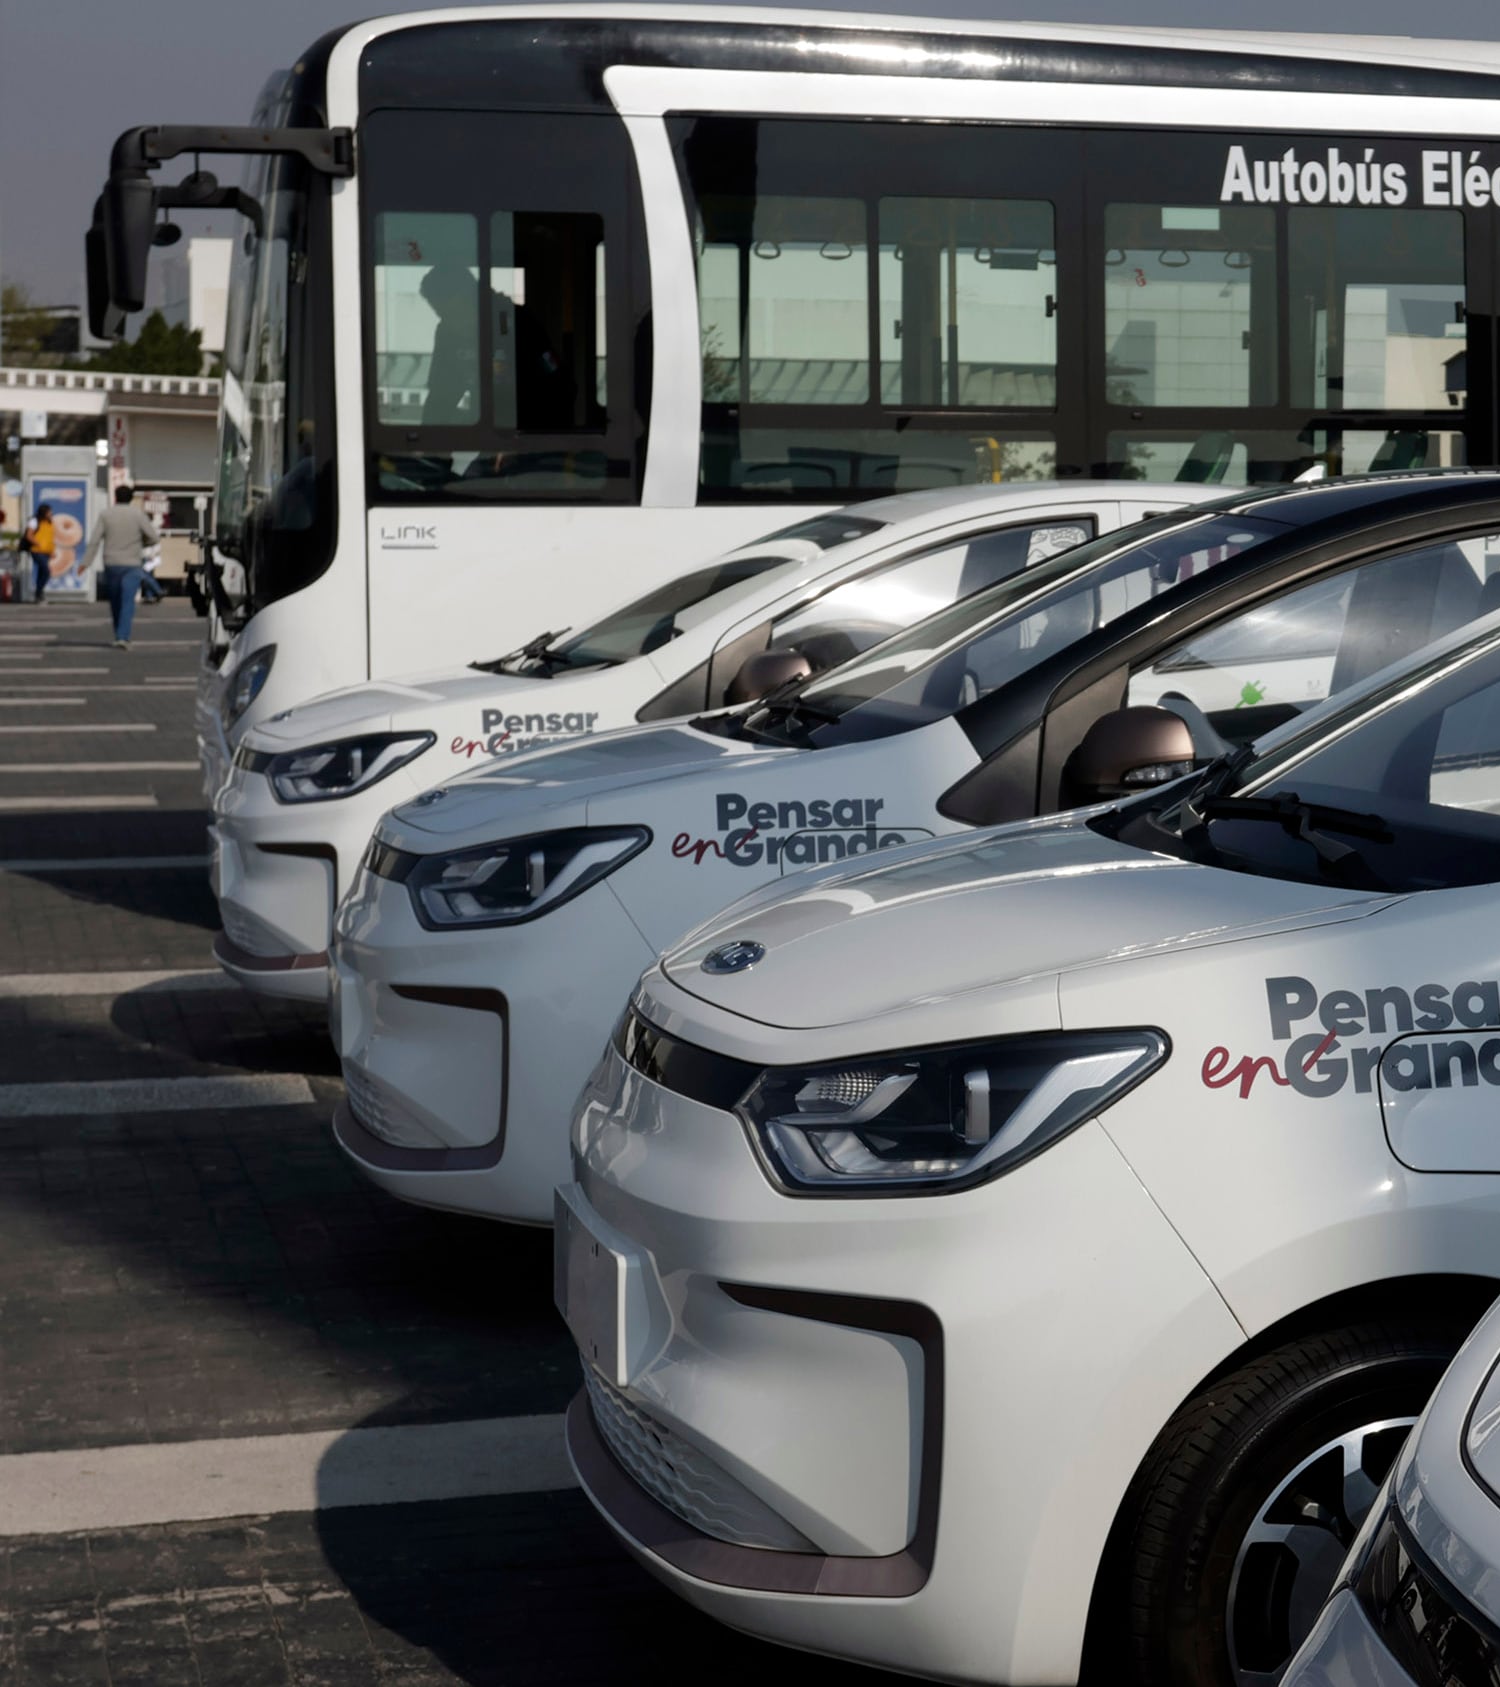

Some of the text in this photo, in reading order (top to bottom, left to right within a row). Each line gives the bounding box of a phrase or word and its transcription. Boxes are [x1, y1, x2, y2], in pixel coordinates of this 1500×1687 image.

[1220, 145, 1408, 206] Autobús
[381, 526, 437, 540] LINK
[482, 708, 598, 734] Pensar
[716, 793, 884, 831] Pensar
[1202, 1046, 1293, 1099] en
